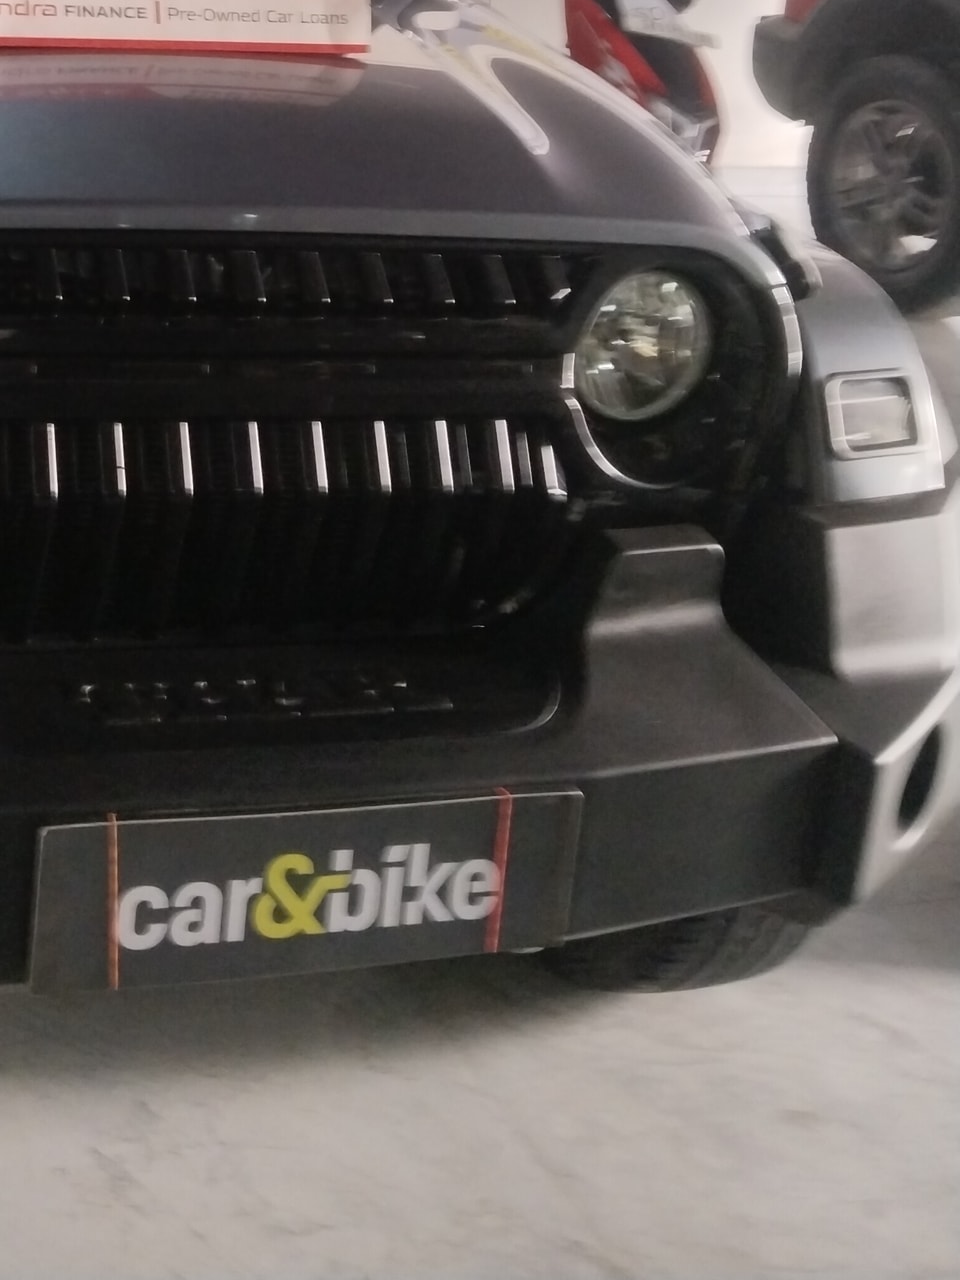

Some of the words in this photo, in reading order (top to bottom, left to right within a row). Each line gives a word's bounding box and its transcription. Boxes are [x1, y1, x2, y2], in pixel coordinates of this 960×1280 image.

[64, 4, 148, 19] FINANCE
[167, 7, 260, 23] Pre-Owned
[266, 10, 294, 24] Car
[301, 10, 349, 25] Loans
[117, 843, 502, 951] car&bike
